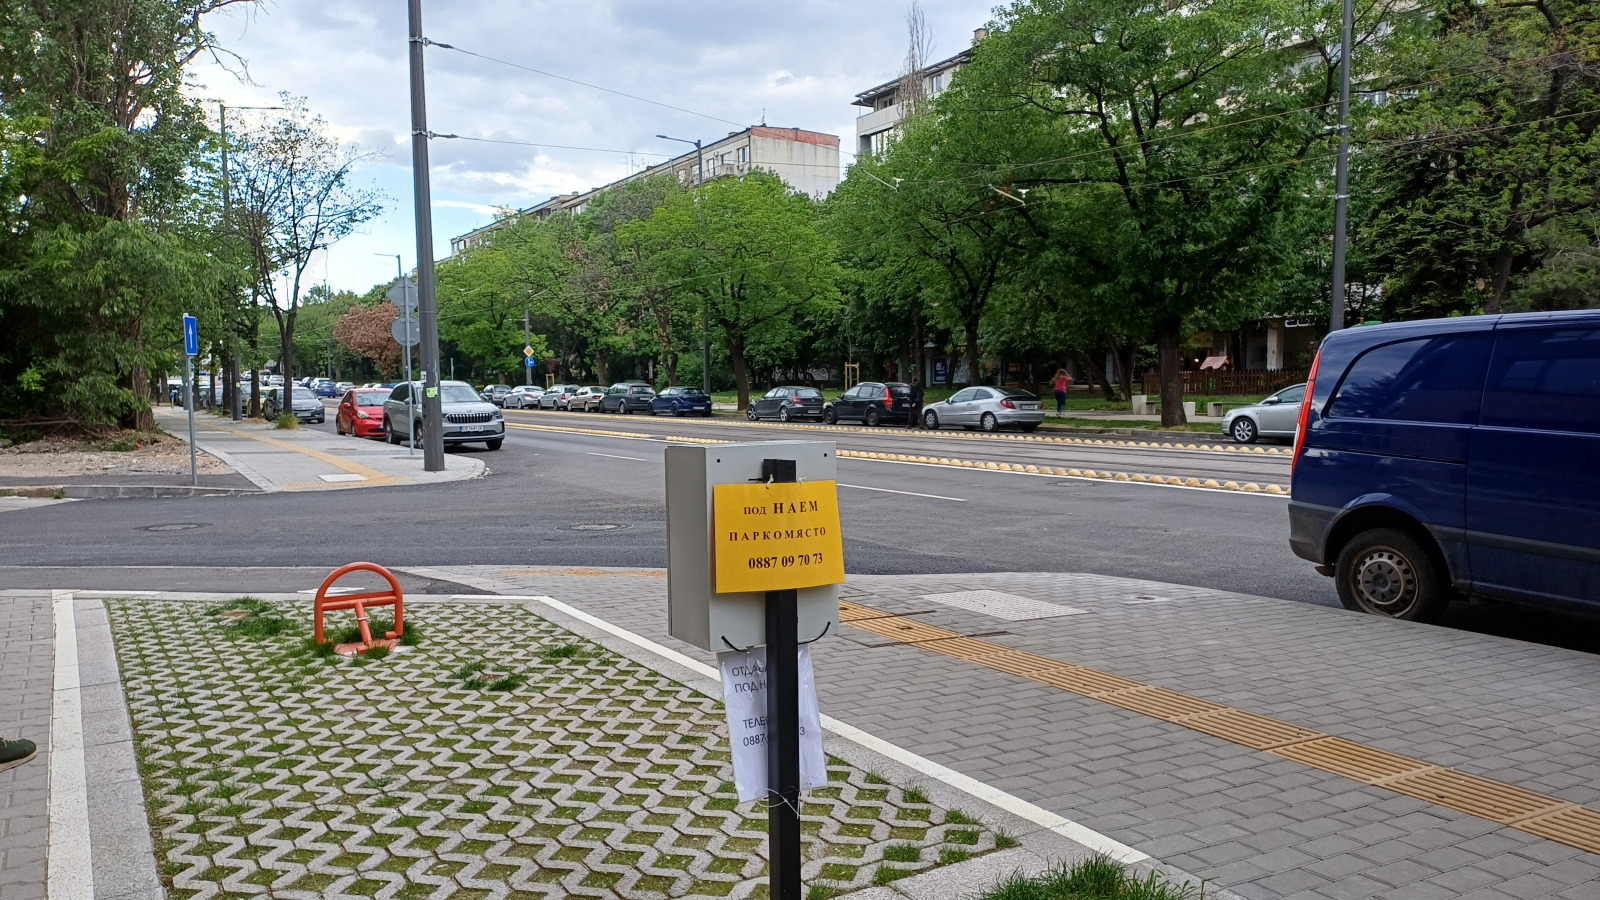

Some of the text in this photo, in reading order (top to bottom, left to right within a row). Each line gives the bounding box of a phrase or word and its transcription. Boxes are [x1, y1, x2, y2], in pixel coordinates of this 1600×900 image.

[773, 500, 818, 514] НАЕМ
[729, 526, 826, 541] ПАРКОМЯСТО
[748, 552, 823, 569] 0887 09 70 73
[734, 681, 759, 693] ПОД
